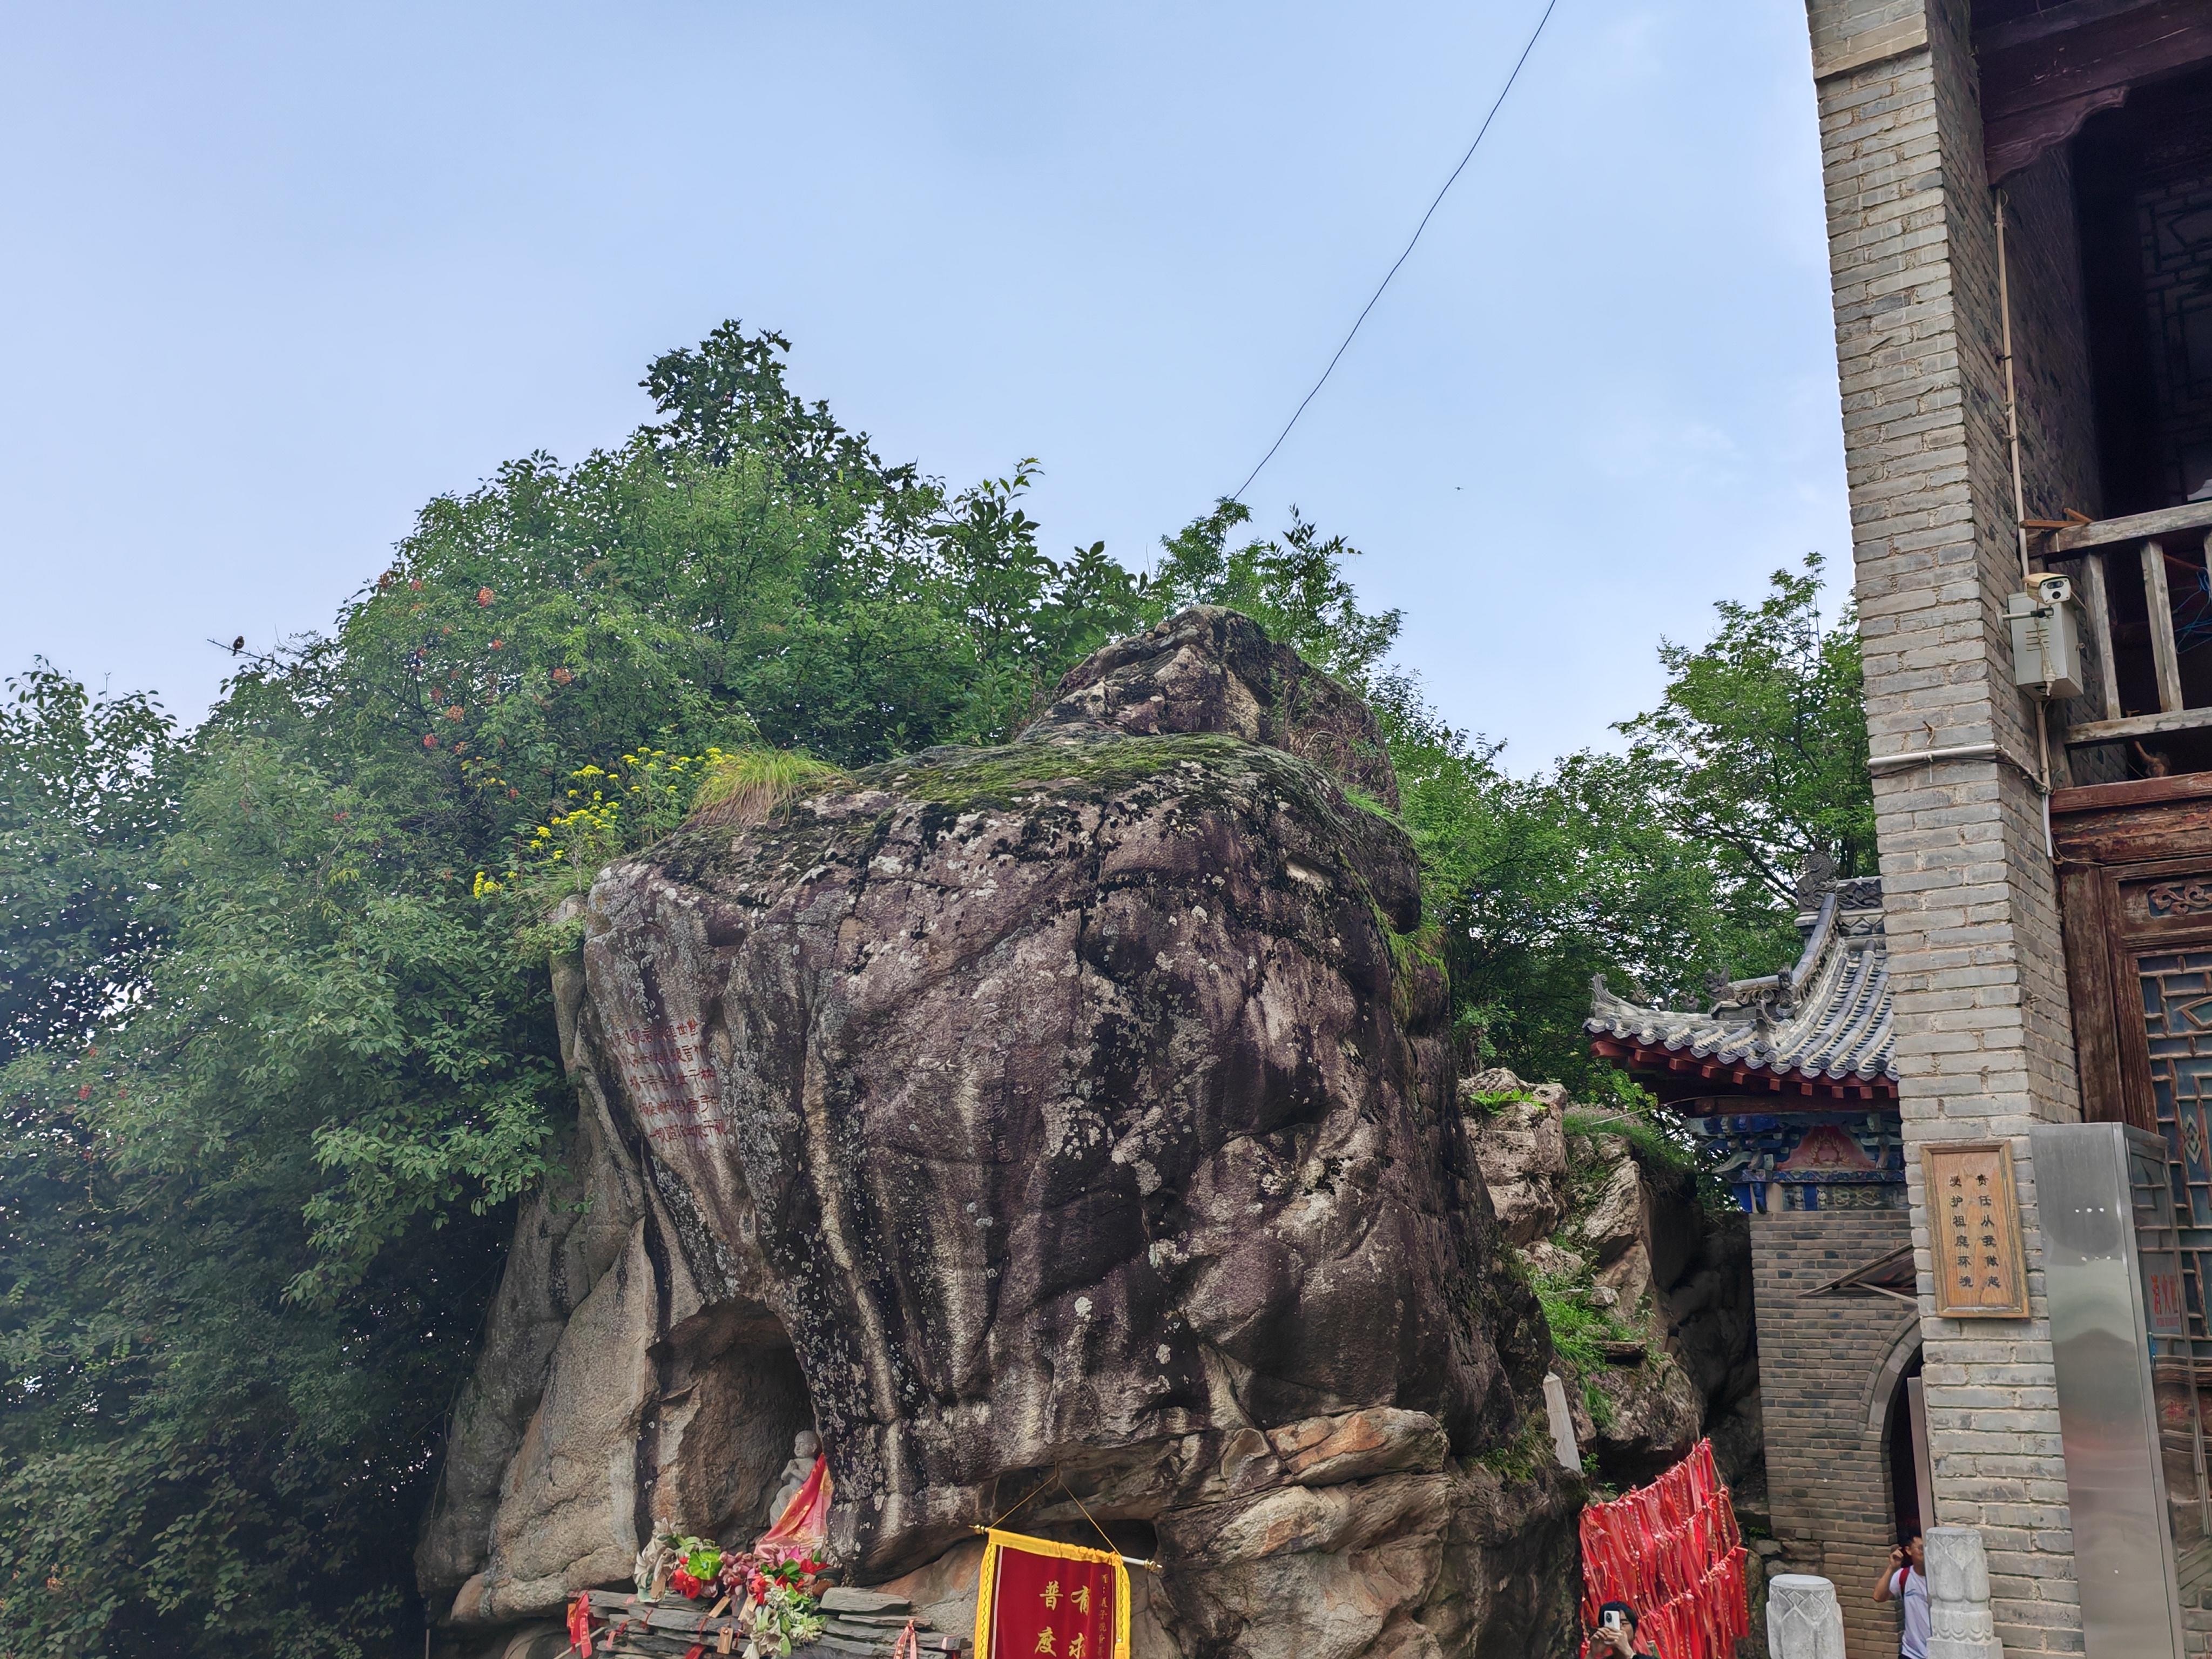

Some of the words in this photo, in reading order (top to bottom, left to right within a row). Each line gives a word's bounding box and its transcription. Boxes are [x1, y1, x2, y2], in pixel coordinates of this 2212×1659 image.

[1948, 1175, 1974, 1288] 爱护祖庭环境
[1975, 1174, 2001, 1288] 责任从我做起
[1034, 1580, 1064, 1657] 普度
[1068, 1584, 1091, 1659] 有求
